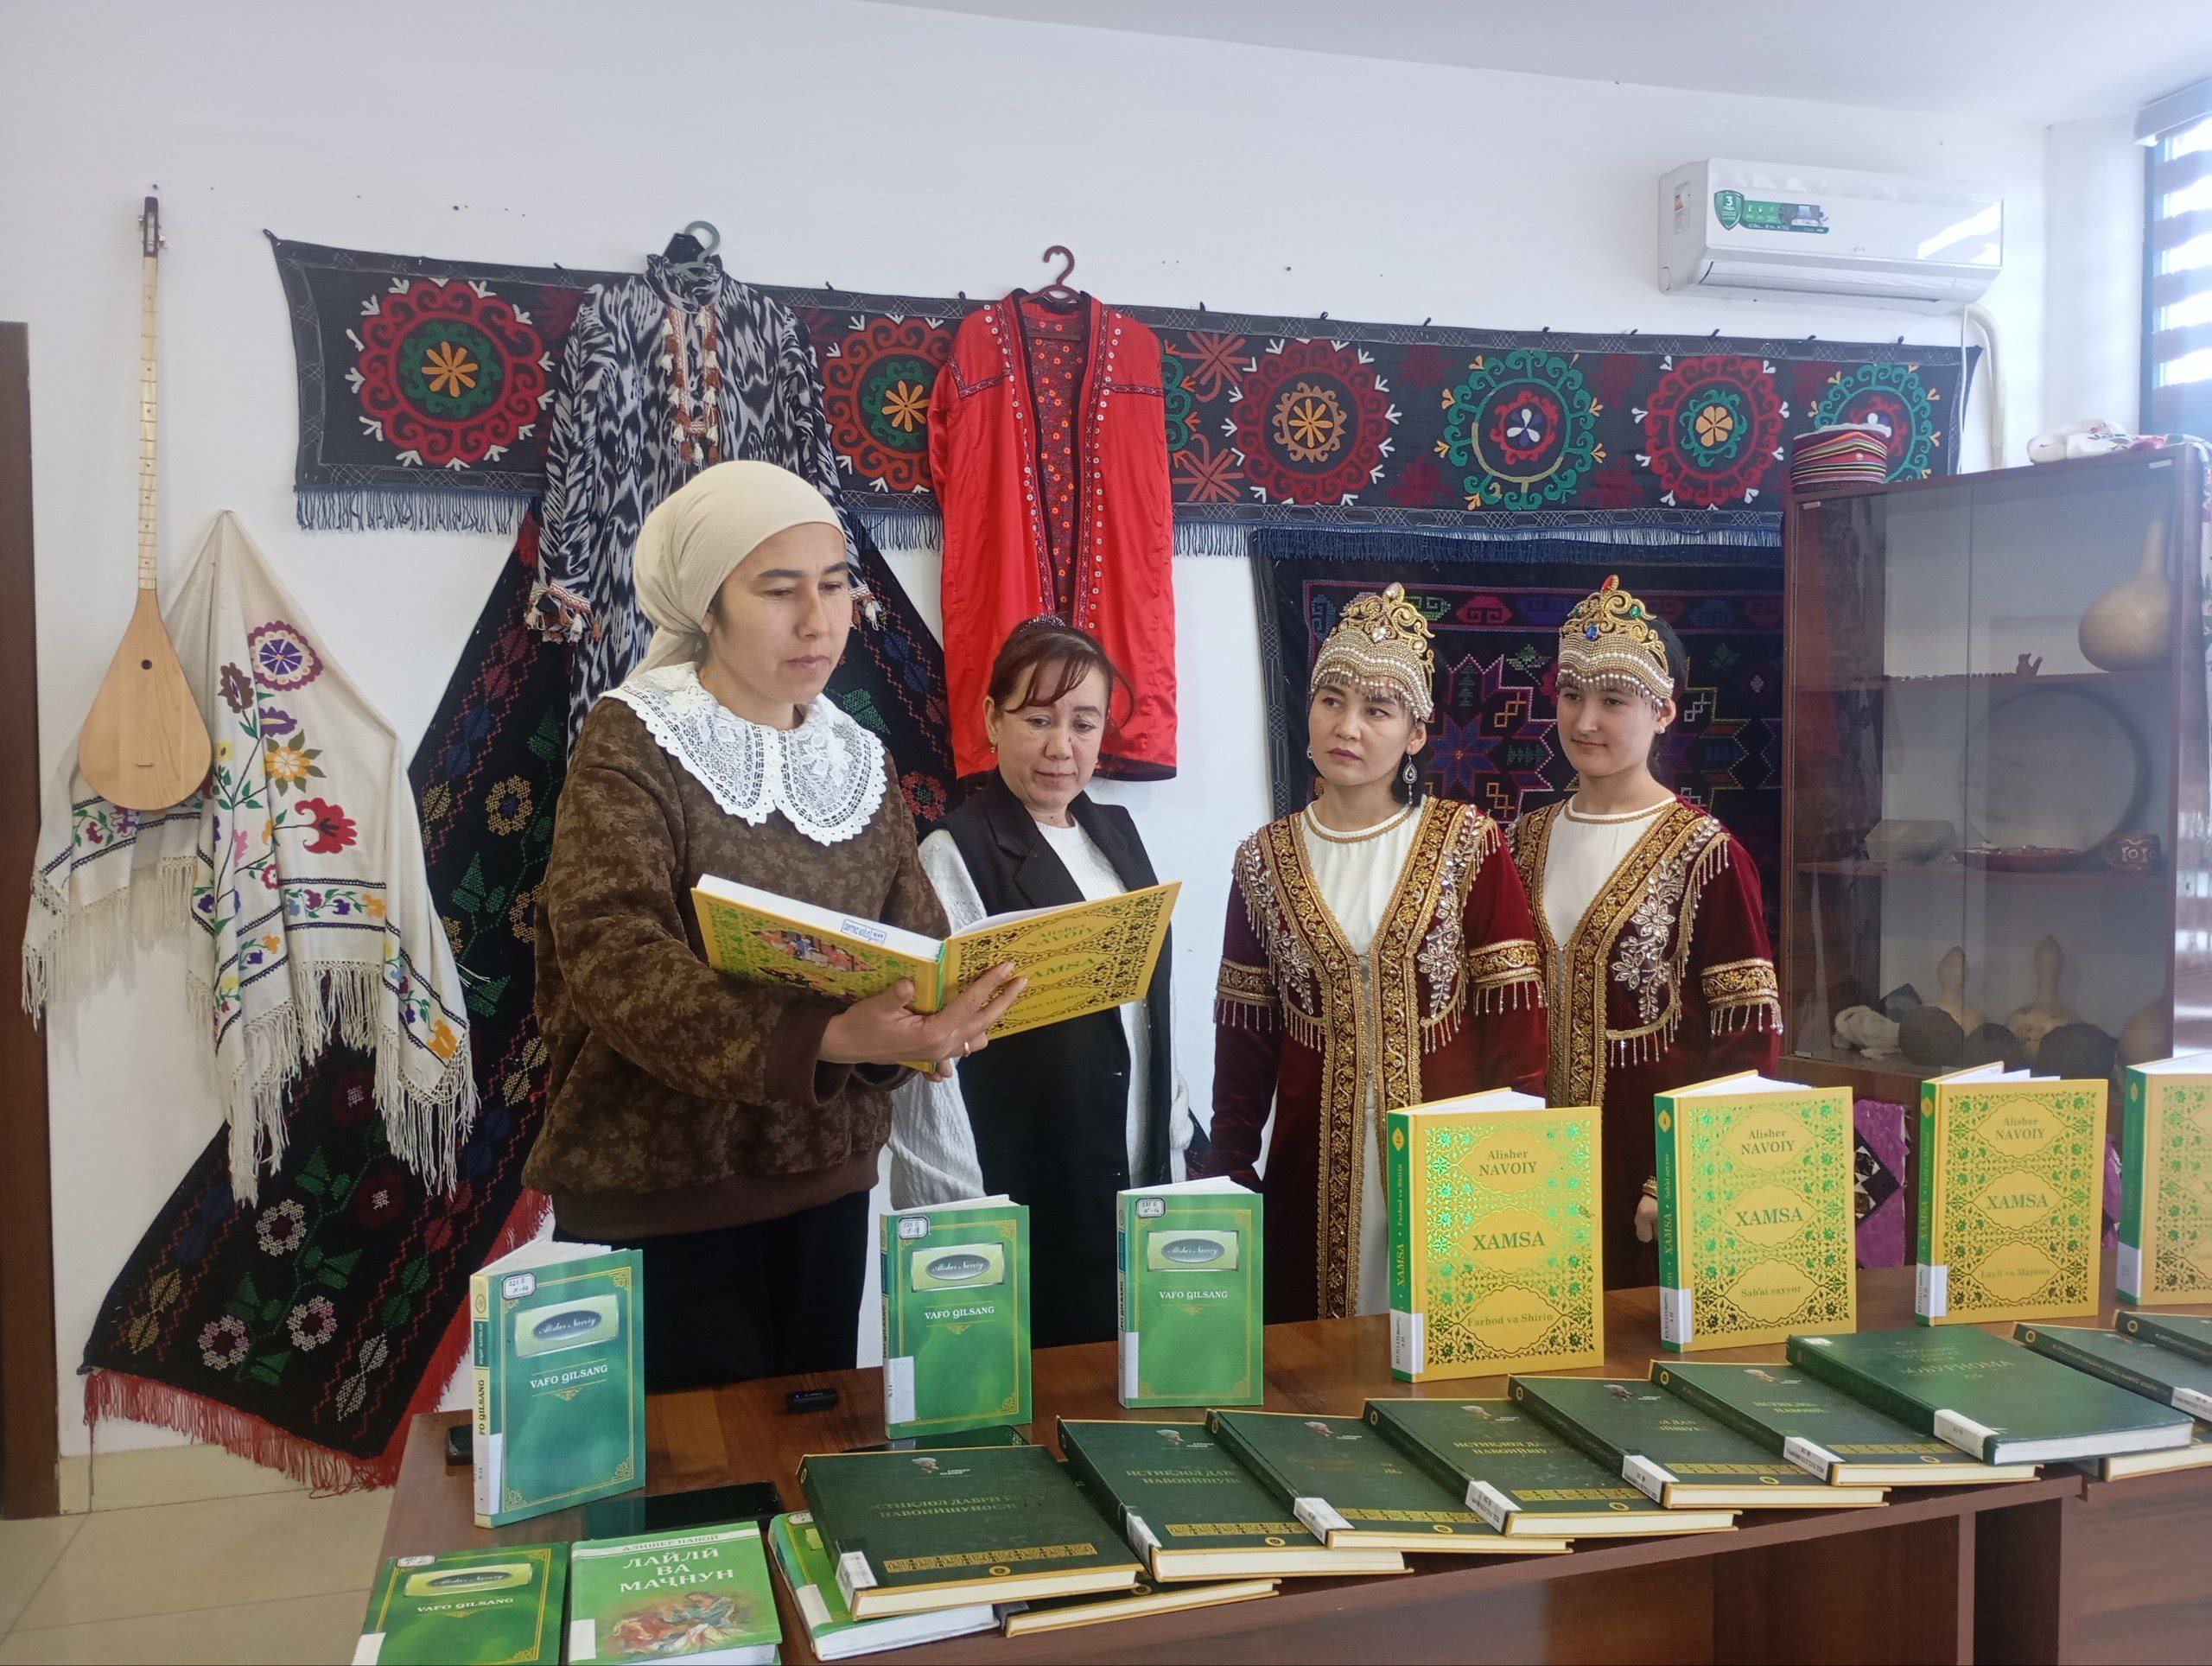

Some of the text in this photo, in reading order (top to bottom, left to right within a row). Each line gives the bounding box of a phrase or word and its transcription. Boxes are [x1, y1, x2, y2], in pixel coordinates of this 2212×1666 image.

[1726, 195, 1733, 207] 3
[1028, 957, 1095, 980] AMSA
[2004, 1116, 2039, 1127] Alisher
[1748, 1128, 1787, 1139] Alisher
[1995, 1128, 2046, 1141] NAVOIY
[1487, 1148, 1529, 1160] Alisher
[1740, 1140, 1795, 1155] NAVOIY
[1478, 1161, 1536, 1177] NAVOIY
[1986, 1194, 2049, 1210] XAMSA
[1736, 1207, 1804, 1227] XAMSA
[1472, 1230, 1546, 1251] XAMSA
[1186, 1291, 1228, 1300] QILSANG
[925, 1306, 995, 1319] VAFO QILSANG
[1467, 1313, 1554, 1327] Farhod va Shirin
[530, 1364, 608, 1389] VAFO QILSANG
[657, 1563, 690, 1576] ВА
[416, 1598, 514, 1612] VAFO QILSANG
